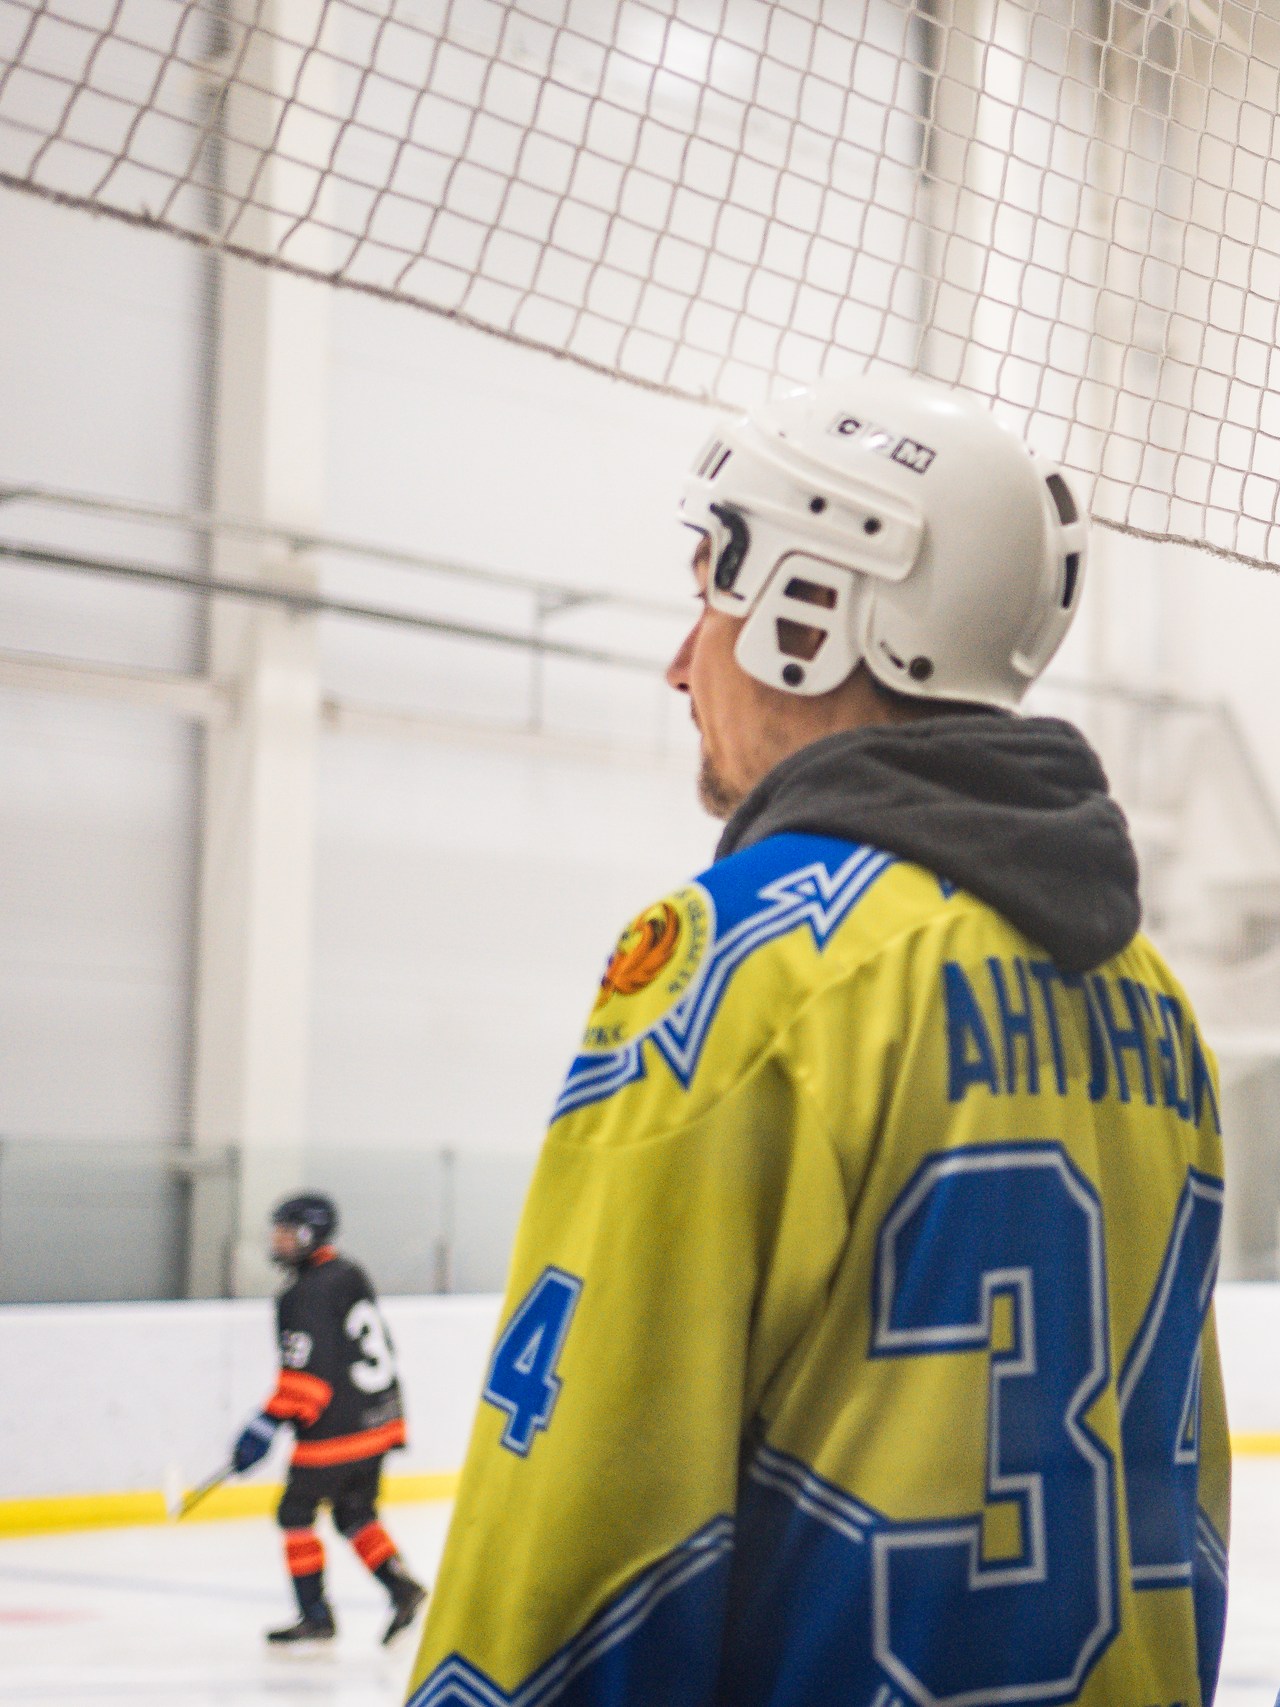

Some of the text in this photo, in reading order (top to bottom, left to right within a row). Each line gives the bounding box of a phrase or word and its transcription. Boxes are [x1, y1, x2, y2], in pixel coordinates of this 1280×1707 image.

[837, 417, 938, 475] CM
[481, 1264, 585, 1459] 4
[867, 1139, 1225, 1707] 34
